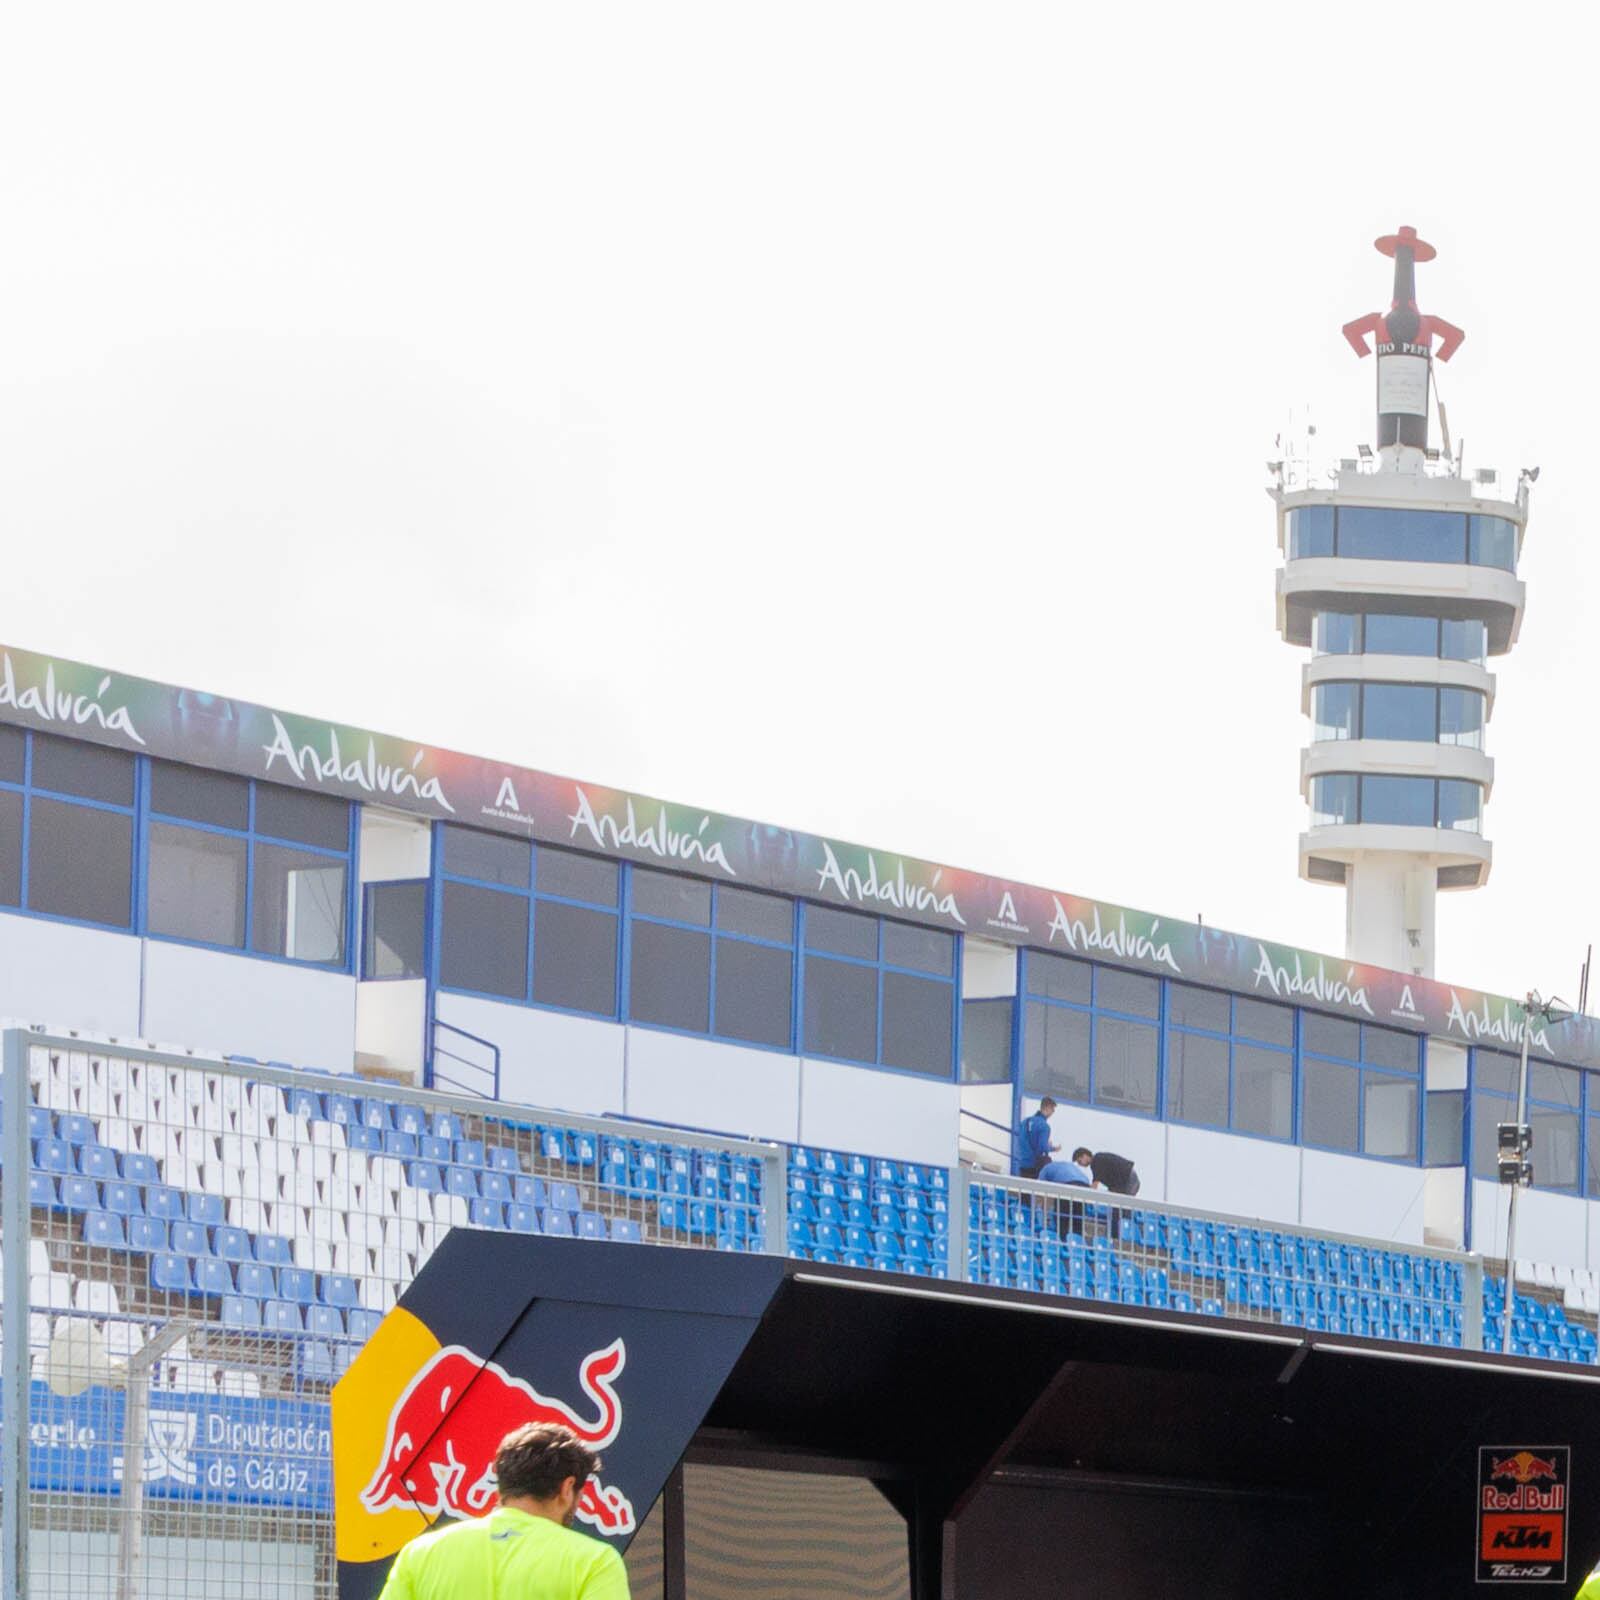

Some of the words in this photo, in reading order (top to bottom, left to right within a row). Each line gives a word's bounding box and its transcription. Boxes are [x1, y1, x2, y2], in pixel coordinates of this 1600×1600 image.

[262, 714, 455, 813] Andalucía
[569, 786, 736, 875] Andalucía
[817, 842, 966, 925] Andalucía
[1047, 895, 1181, 973] Andalucía
[1253, 942, 1374, 1016] Andalucía
[207, 1413, 331, 1453] Diputación
[207, 1460, 237, 1489] de
[243, 1458, 309, 1493] Cádiz
[1482, 1485, 1521, 1510] Red
[1523, 1485, 1564, 1511] Bull
[1491, 1525, 1552, 1549] KTM
